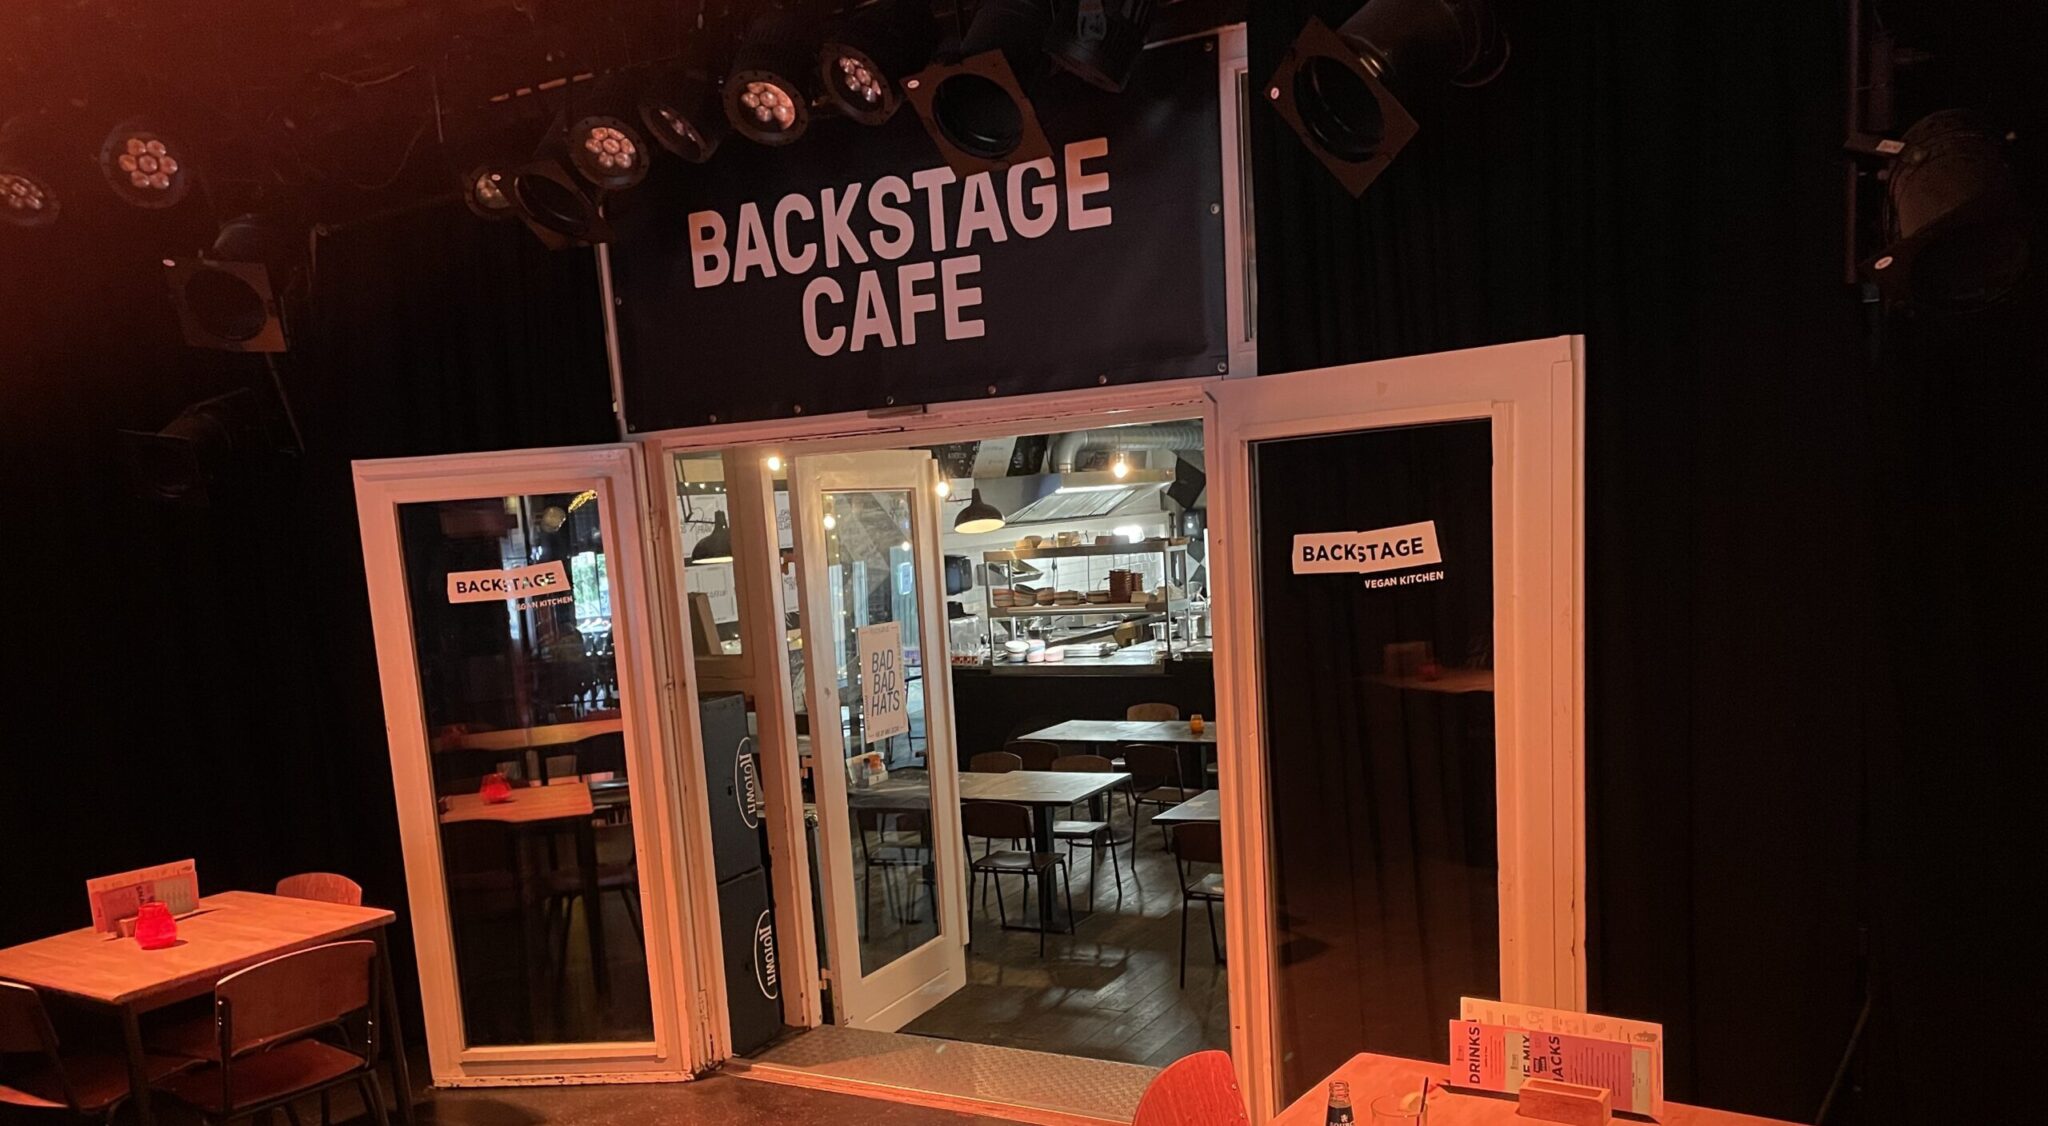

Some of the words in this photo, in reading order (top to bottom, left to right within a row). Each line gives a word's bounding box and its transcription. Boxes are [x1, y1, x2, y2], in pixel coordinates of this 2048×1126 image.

[687, 137, 1113, 289] BACKSTAGE
[802, 254, 986, 357] CAFE
[1302, 537, 1424, 562] BACKSTAGE
[1364, 577, 1397, 589] VEGAN
[1399, 570, 1445, 585] KITCHEN
[515, 601, 538, 611] EGAN
[539, 596, 573, 608] KITCHEN
[871, 648, 894, 673] BAD
[873, 670, 895, 695] BAD
[871, 690, 900, 717] HATS
[1468, 1027, 1480, 1084] DRINKS
[1548, 1035, 1564, 1082] ACKS
